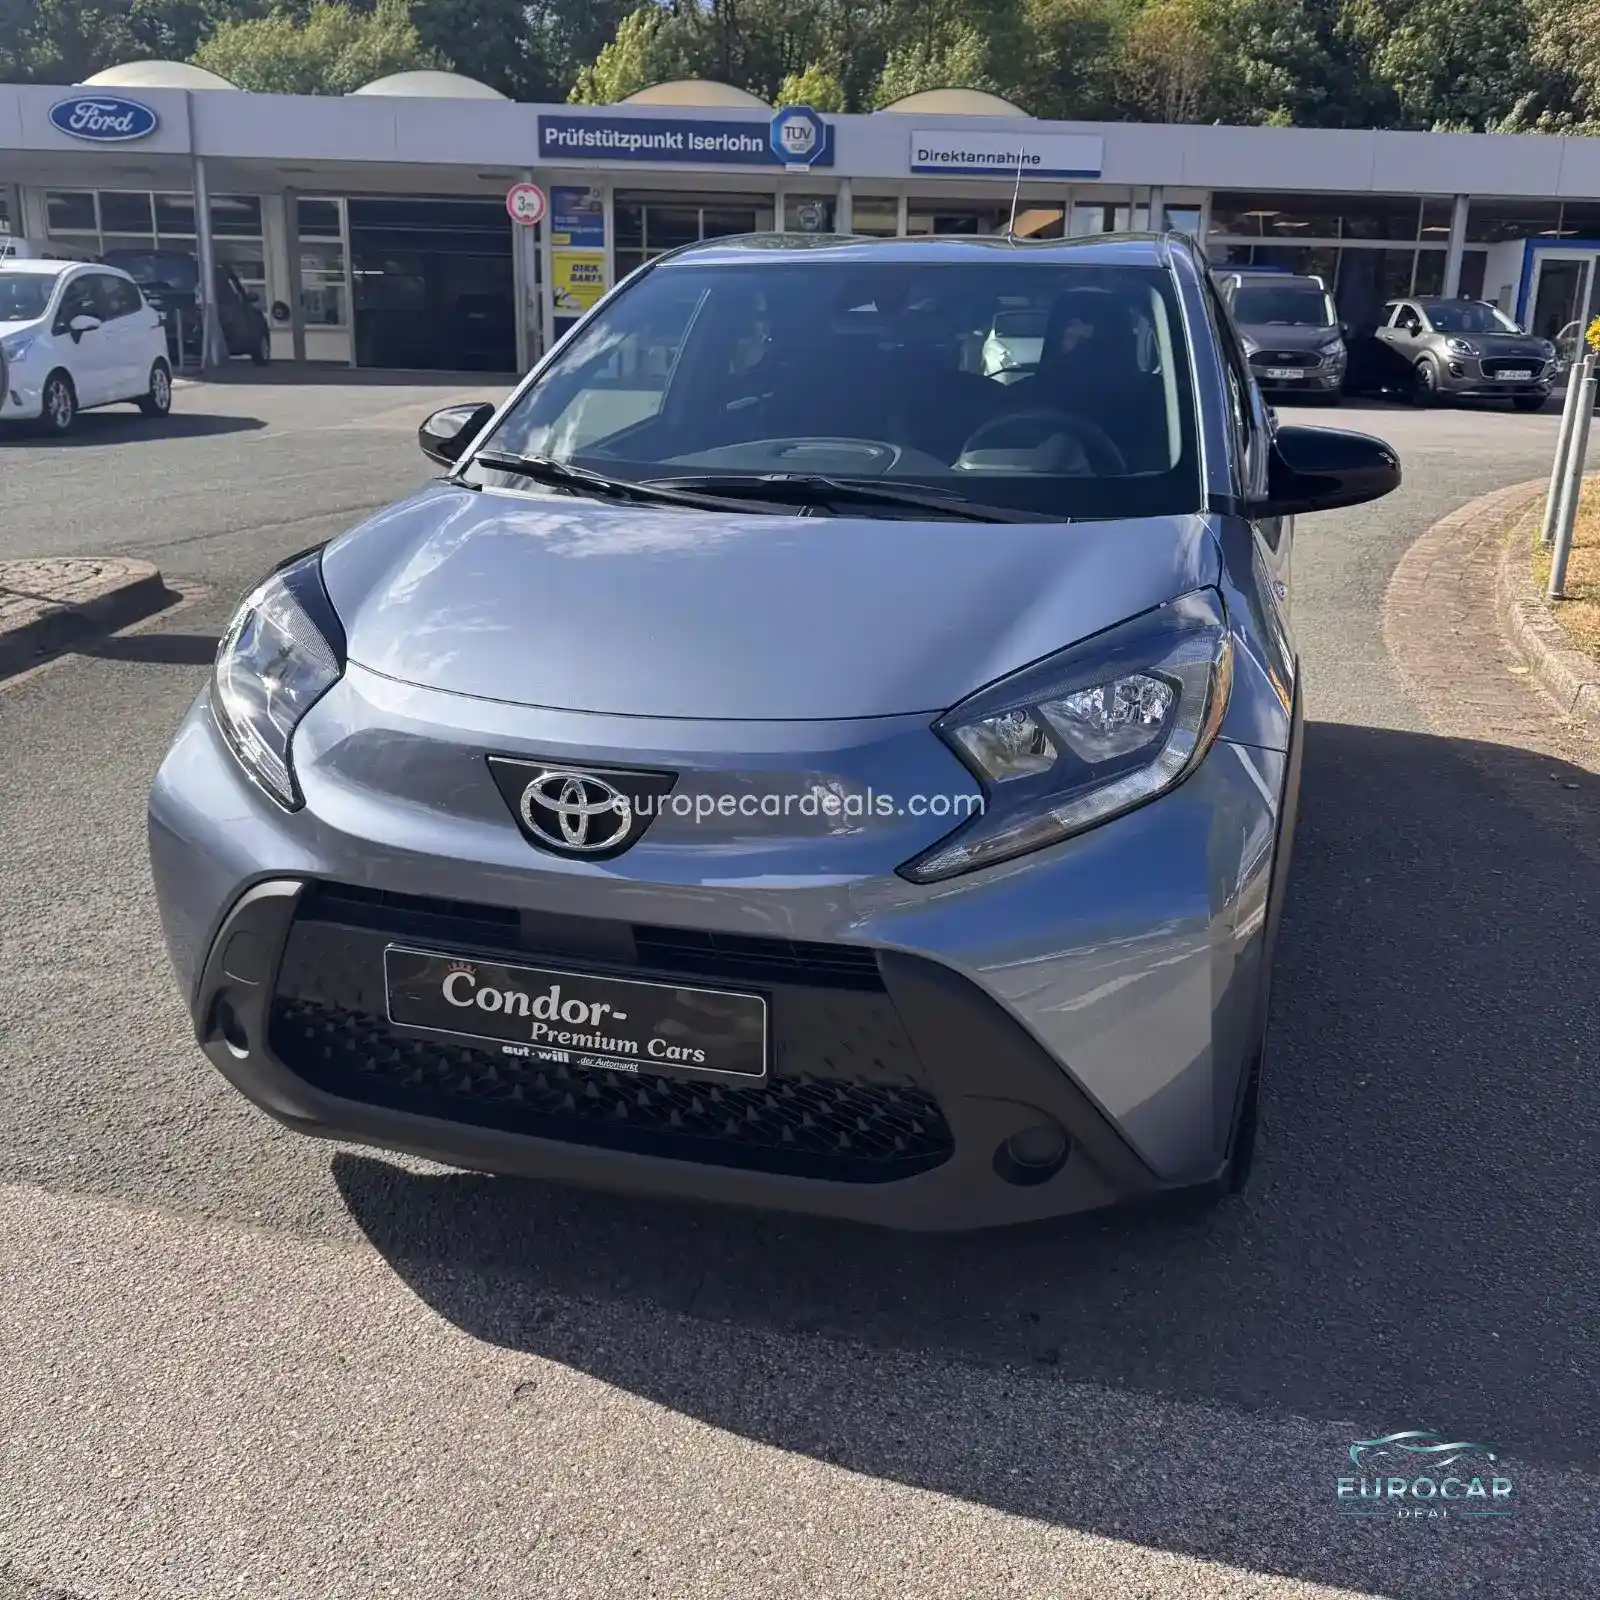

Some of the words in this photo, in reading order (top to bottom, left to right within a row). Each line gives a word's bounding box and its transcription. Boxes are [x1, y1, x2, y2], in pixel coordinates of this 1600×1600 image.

[69, 102, 133, 131] Ford
[545, 127, 683, 151] Prüfstützpunkt
[688, 134, 764, 152] Iserlohn
[917, 149, 1041, 164] Direktannahme
[442, 971, 628, 1026] Condor-
[531, 1021, 639, 1053] Premium
[647, 1038, 706, 1063] Cars
[595, 1058, 639, 1072] Automarkt
